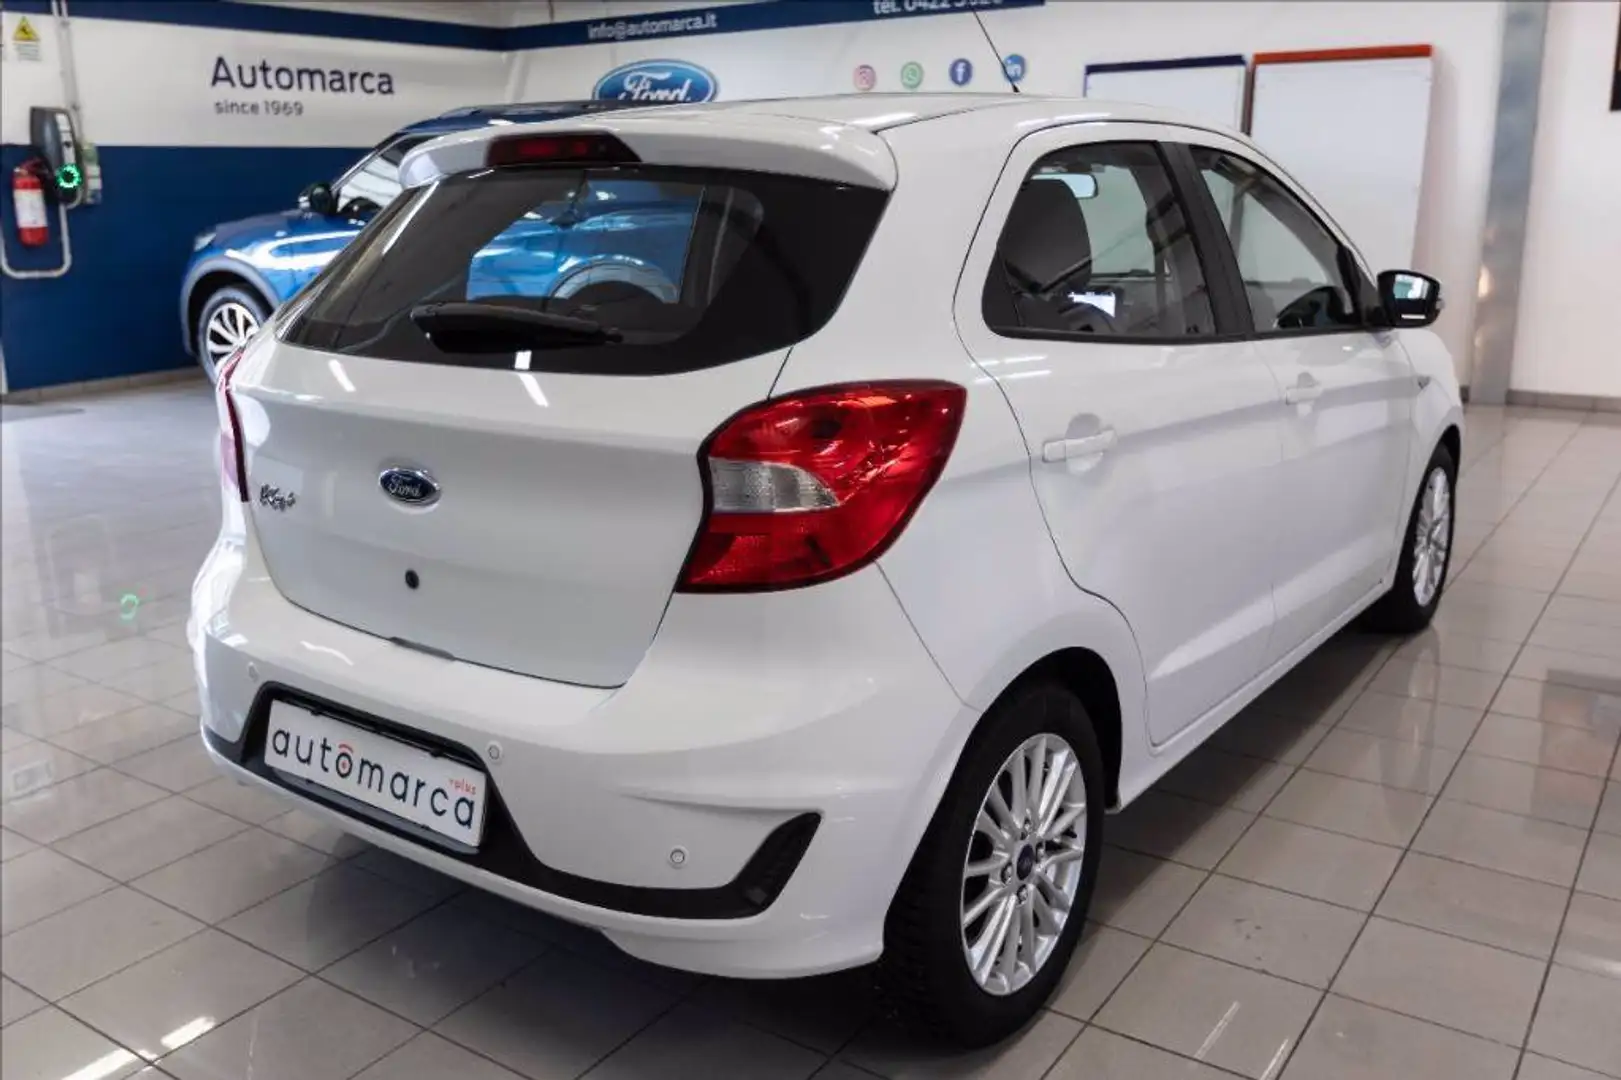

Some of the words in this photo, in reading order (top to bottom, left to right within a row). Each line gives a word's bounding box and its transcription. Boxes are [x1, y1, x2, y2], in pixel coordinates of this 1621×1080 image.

[587, 12, 718, 40] info@automarca.it
[211, 56, 395, 94] Automarca
[617, 71, 693, 101] Ford
[214, 101, 259, 115] since
[264, 101, 304, 116] 1969
[271, 728, 475, 830] automarca
